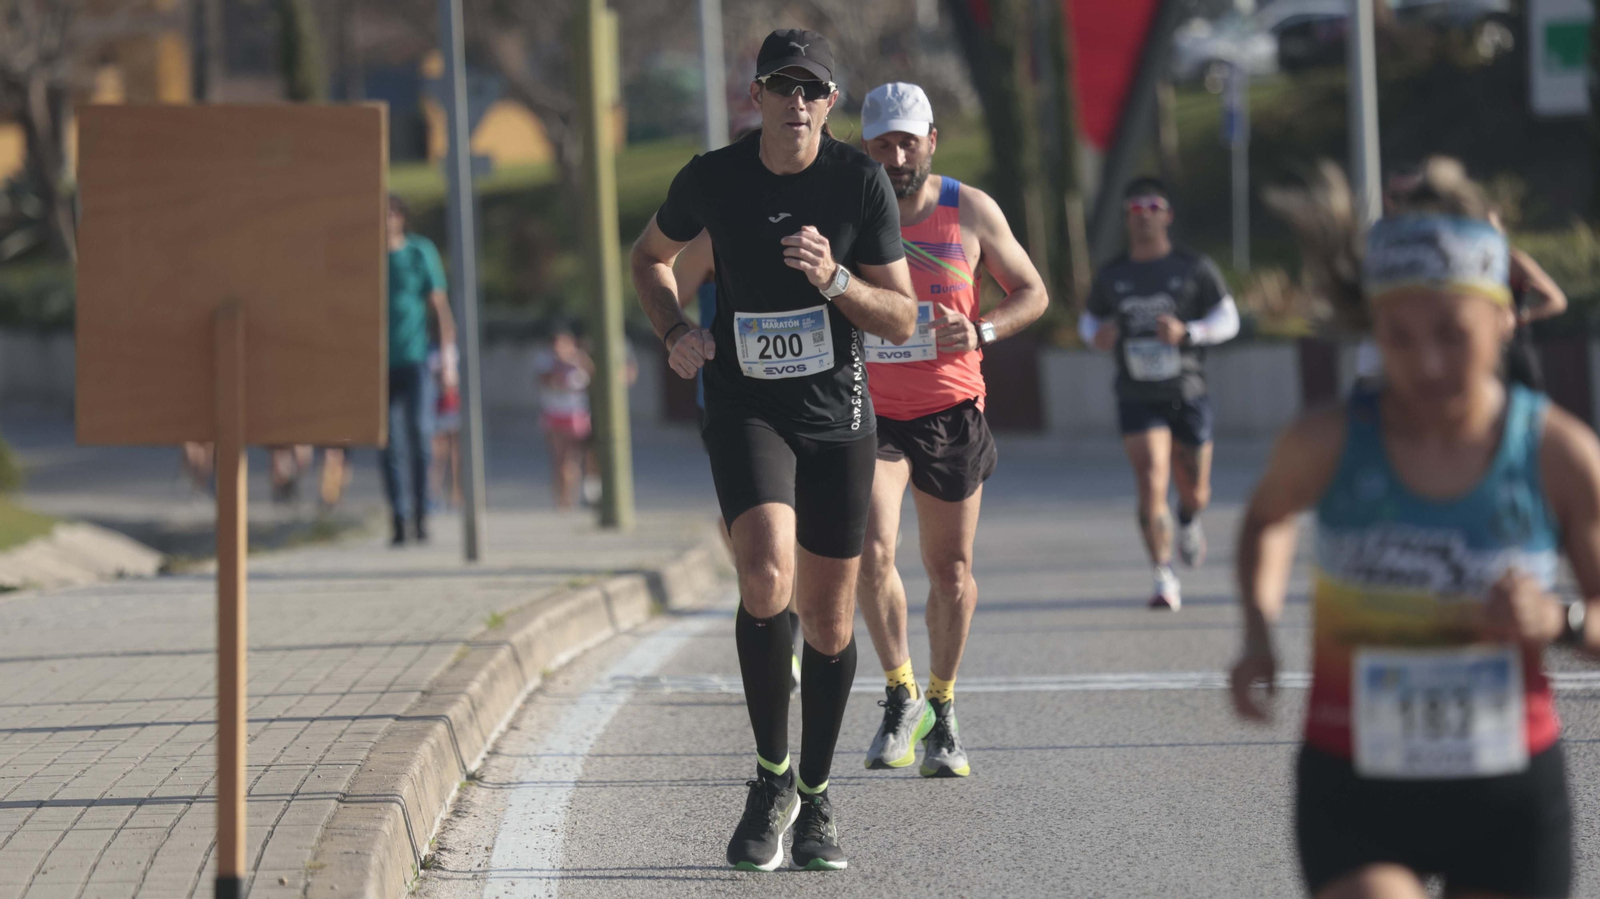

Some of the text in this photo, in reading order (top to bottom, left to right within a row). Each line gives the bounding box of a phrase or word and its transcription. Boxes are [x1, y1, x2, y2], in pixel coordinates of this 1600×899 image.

[762, 319, 800, 329] MARATÓN
[756, 333, 803, 360] 200
[876, 350, 912, 359] EVOS
[763, 364, 807, 375] EVOS
